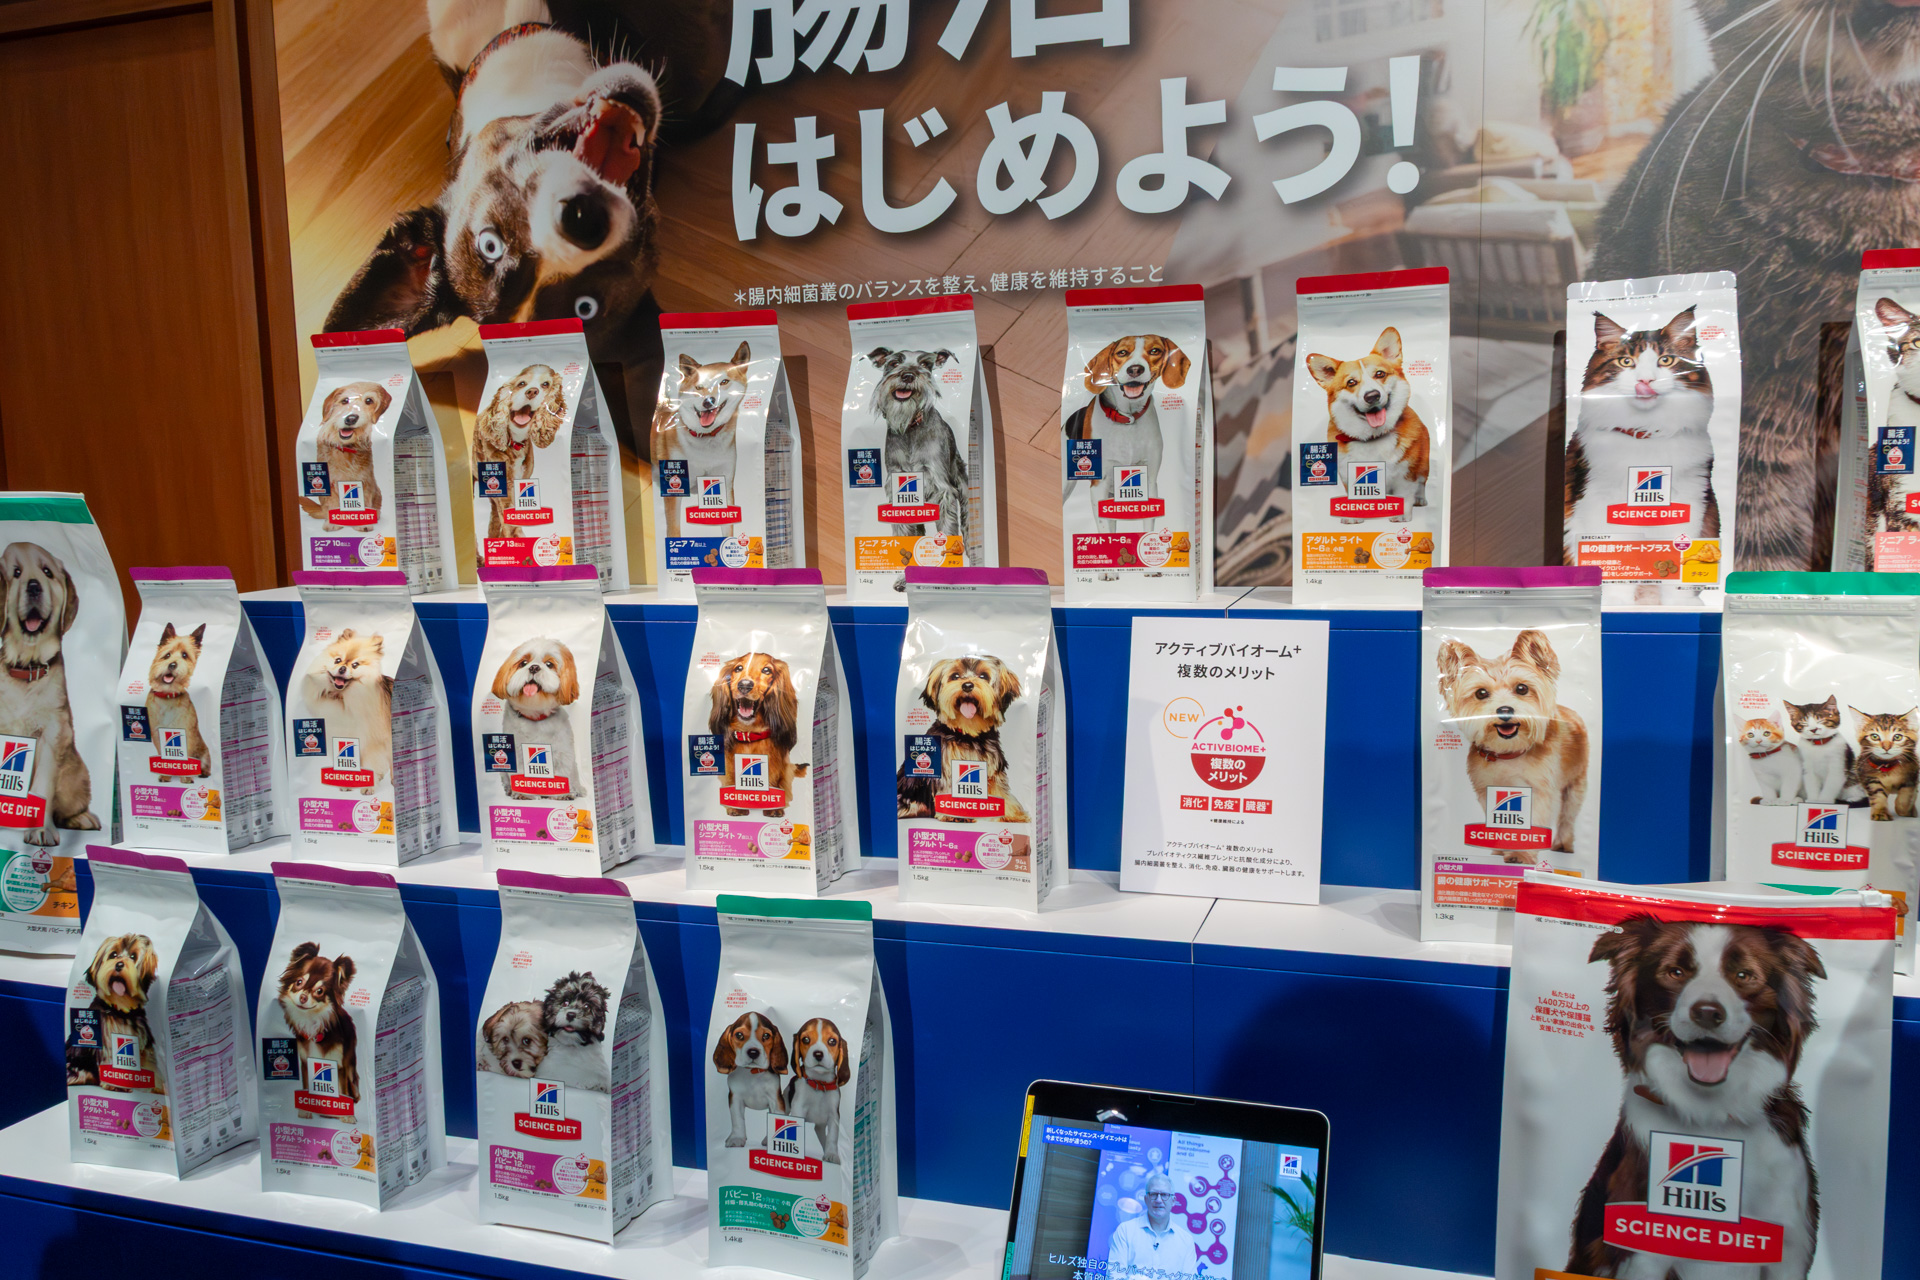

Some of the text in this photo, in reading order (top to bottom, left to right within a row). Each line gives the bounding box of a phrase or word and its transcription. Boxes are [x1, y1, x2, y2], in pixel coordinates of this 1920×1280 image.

[731, 55, 1422, 241] はじめよう!
[1120, 489, 1143, 498] Hill's
[1354, 486, 1380, 496] Hill's
[703, 497, 723, 505] Hill's
[897, 495, 919, 503] Hill's
[1634, 492, 1664, 502] Hill's
[343, 500, 361, 508] Hill's
[519, 499, 536, 507] Hill's
[1102, 504, 1160, 513] SCIENCE DIET
[1612, 510, 1685, 518] SCIENCE DIET
[1306, 536, 1363, 544] アダルト ライト
[1880, 536, 1905, 544] シニア
[1177, 664, 1275, 680] 複数のメリット
[1170, 713, 1199, 722] NEW
[165, 748, 184, 757] Hill's
[1192, 743, 1266, 753] ACTIVBIOME+
[182, 763, 198, 771] DIET
[338, 759, 357, 768] Hill's
[1211, 758, 1245, 770] 複数の
[529, 765, 550, 774] Hill's
[324, 773, 353, 781] SCIENCE
[740, 777, 764, 787] Hill's
[1208, 771, 1247, 783] メリット
[515, 780, 565, 789] SCIENCE DIET
[957, 784, 983, 795] Hill's
[724, 793, 781, 802] SCIENCE DIET
[940, 801, 1000, 811] SCIENCE DIET
[16, 806, 40, 818] DIET
[1493, 813, 1524, 825] Hill's
[699, 823, 729, 831] 小型犬用
[913, 831, 945, 841] 小型犬用
[1470, 831, 1546, 843] SCIENCE DIET
[1804, 831, 1839, 844] Hill's
[913, 840, 936, 848] アダルト
[1778, 851, 1863, 863] SCIENCE DIET
[1551, 990, 1575, 999] 私たちは
[116, 1056, 137, 1067] Hill's
[103, 1071, 151, 1082] SCIENCE DIET
[313, 1082, 335, 1093] Hill's
[298, 1097, 350, 1110] SCIENCE DIET
[535, 1104, 560, 1116] Hill's
[519, 1119, 577, 1134] SCIENCE DIET
[773, 1141, 799, 1154] Hill's
[495, 1148, 524, 1161] 小型犬用
[754, 1156, 818, 1173] SCIENCE DIET
[1662, 1185, 1727, 1214] Hill's
[1615, 1217, 1772, 1251] SCIENCE DIET
